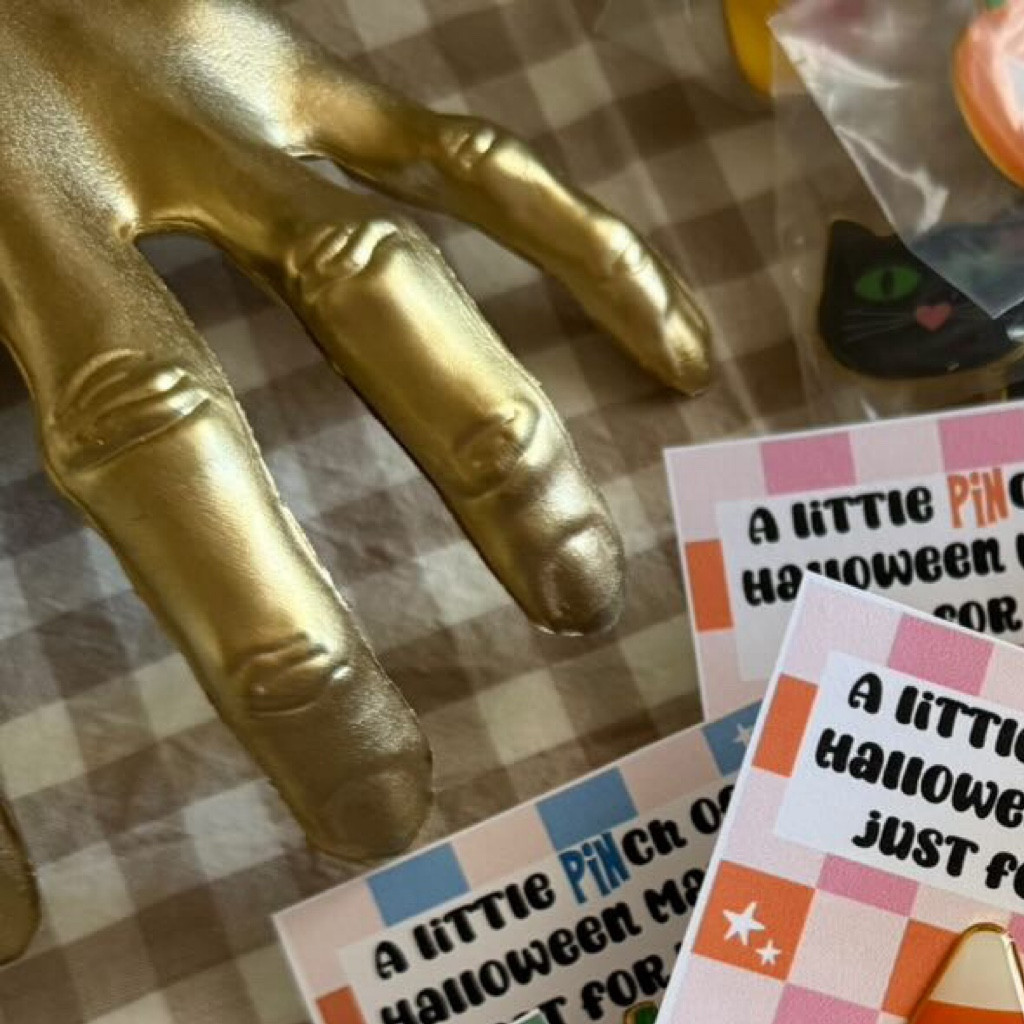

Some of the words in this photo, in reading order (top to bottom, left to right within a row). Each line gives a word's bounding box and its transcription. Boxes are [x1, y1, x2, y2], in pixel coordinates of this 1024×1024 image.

[748, 507, 779, 545] A
[847, 673, 882, 715] A
[374, 940, 409, 980] A
